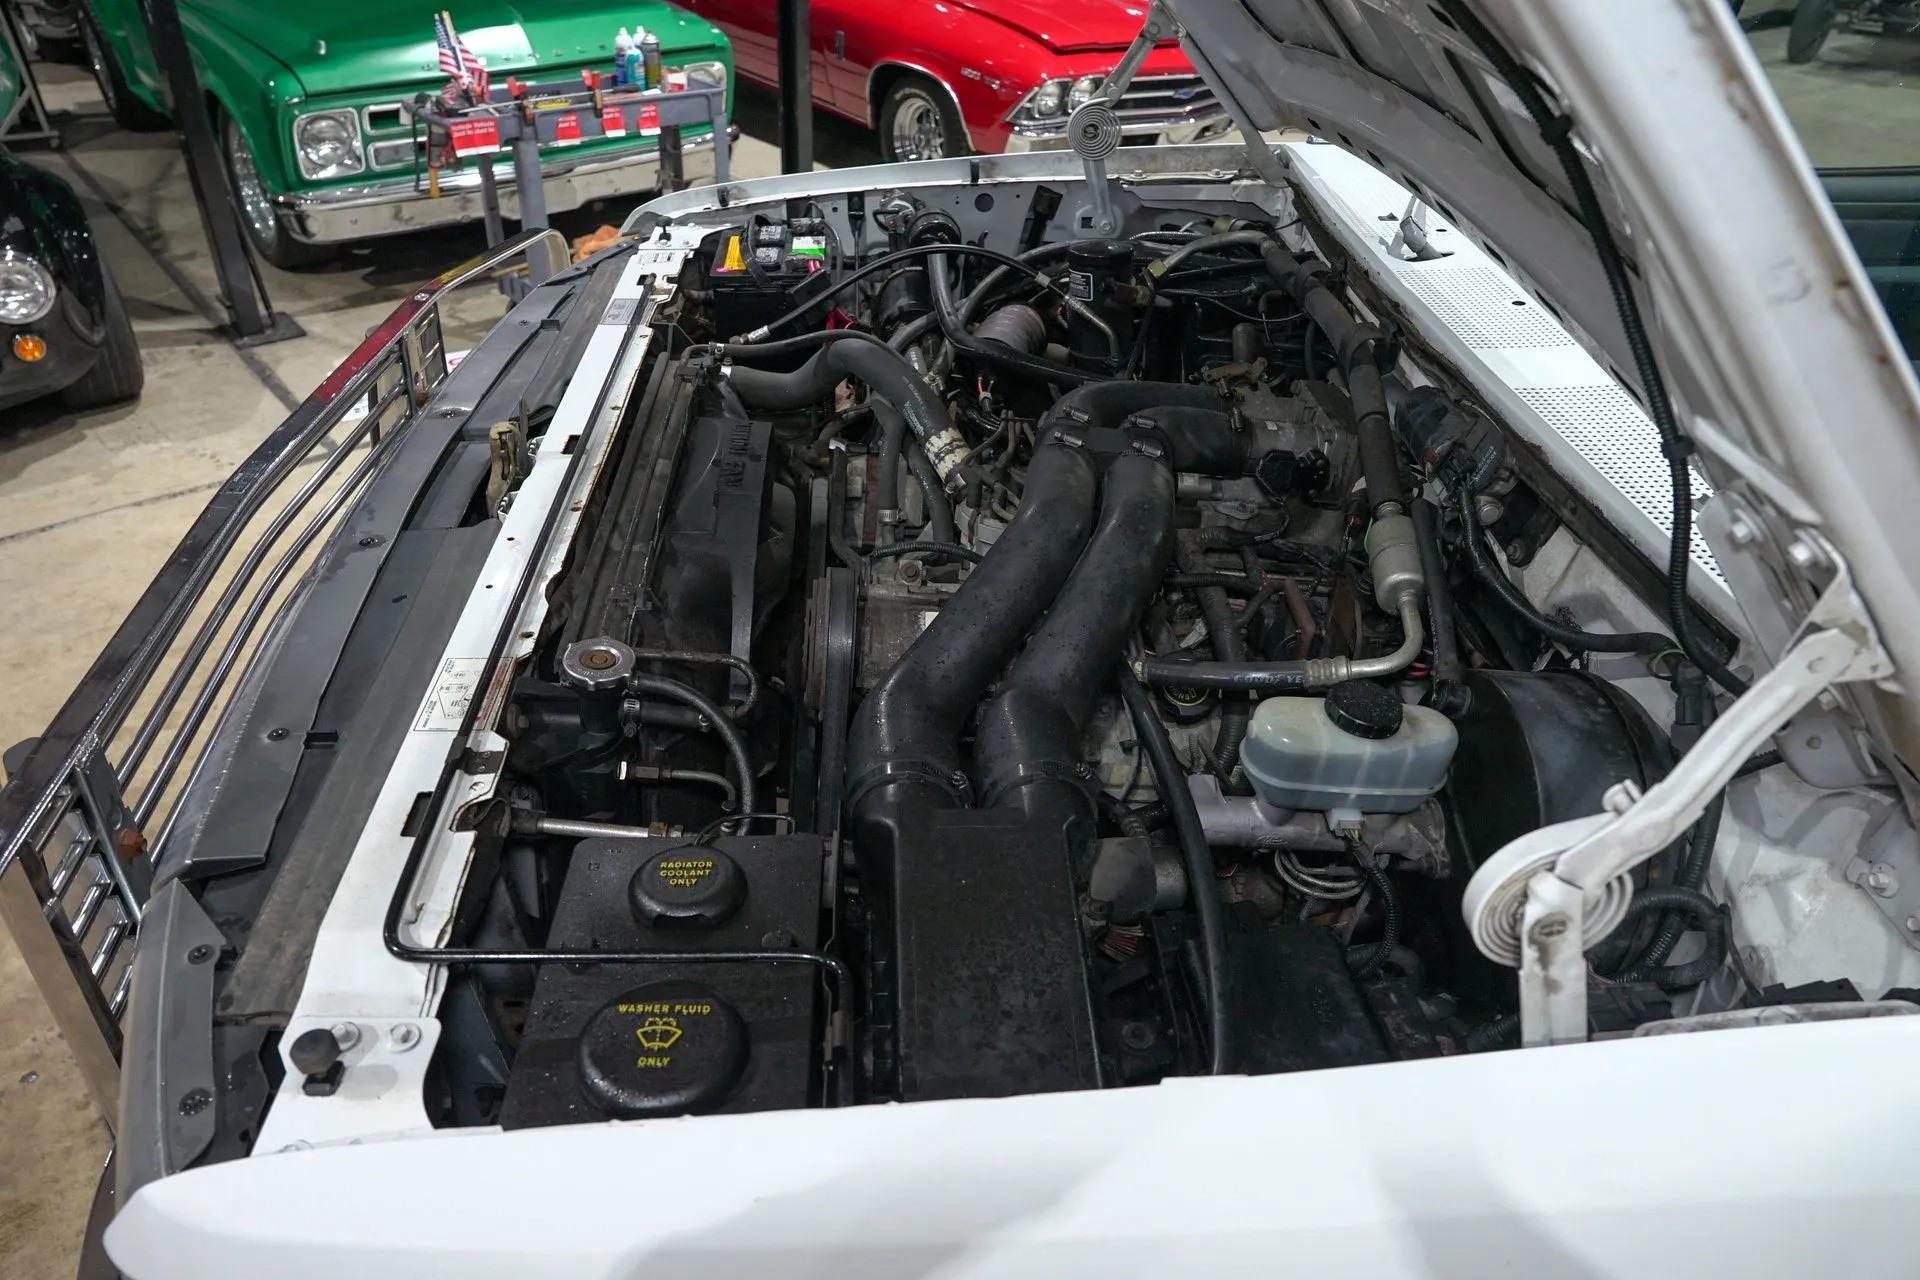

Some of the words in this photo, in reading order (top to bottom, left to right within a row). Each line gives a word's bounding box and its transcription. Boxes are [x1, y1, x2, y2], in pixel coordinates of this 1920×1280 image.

[660, 860, 713, 869] RADIATOR
[659, 869, 711, 878] COOLANT
[669, 878, 698, 886] ONLY
[618, 1004, 670, 1014] WASHER
[674, 1004, 711, 1014] FLUID
[637, 1057, 671, 1068] ONLY
